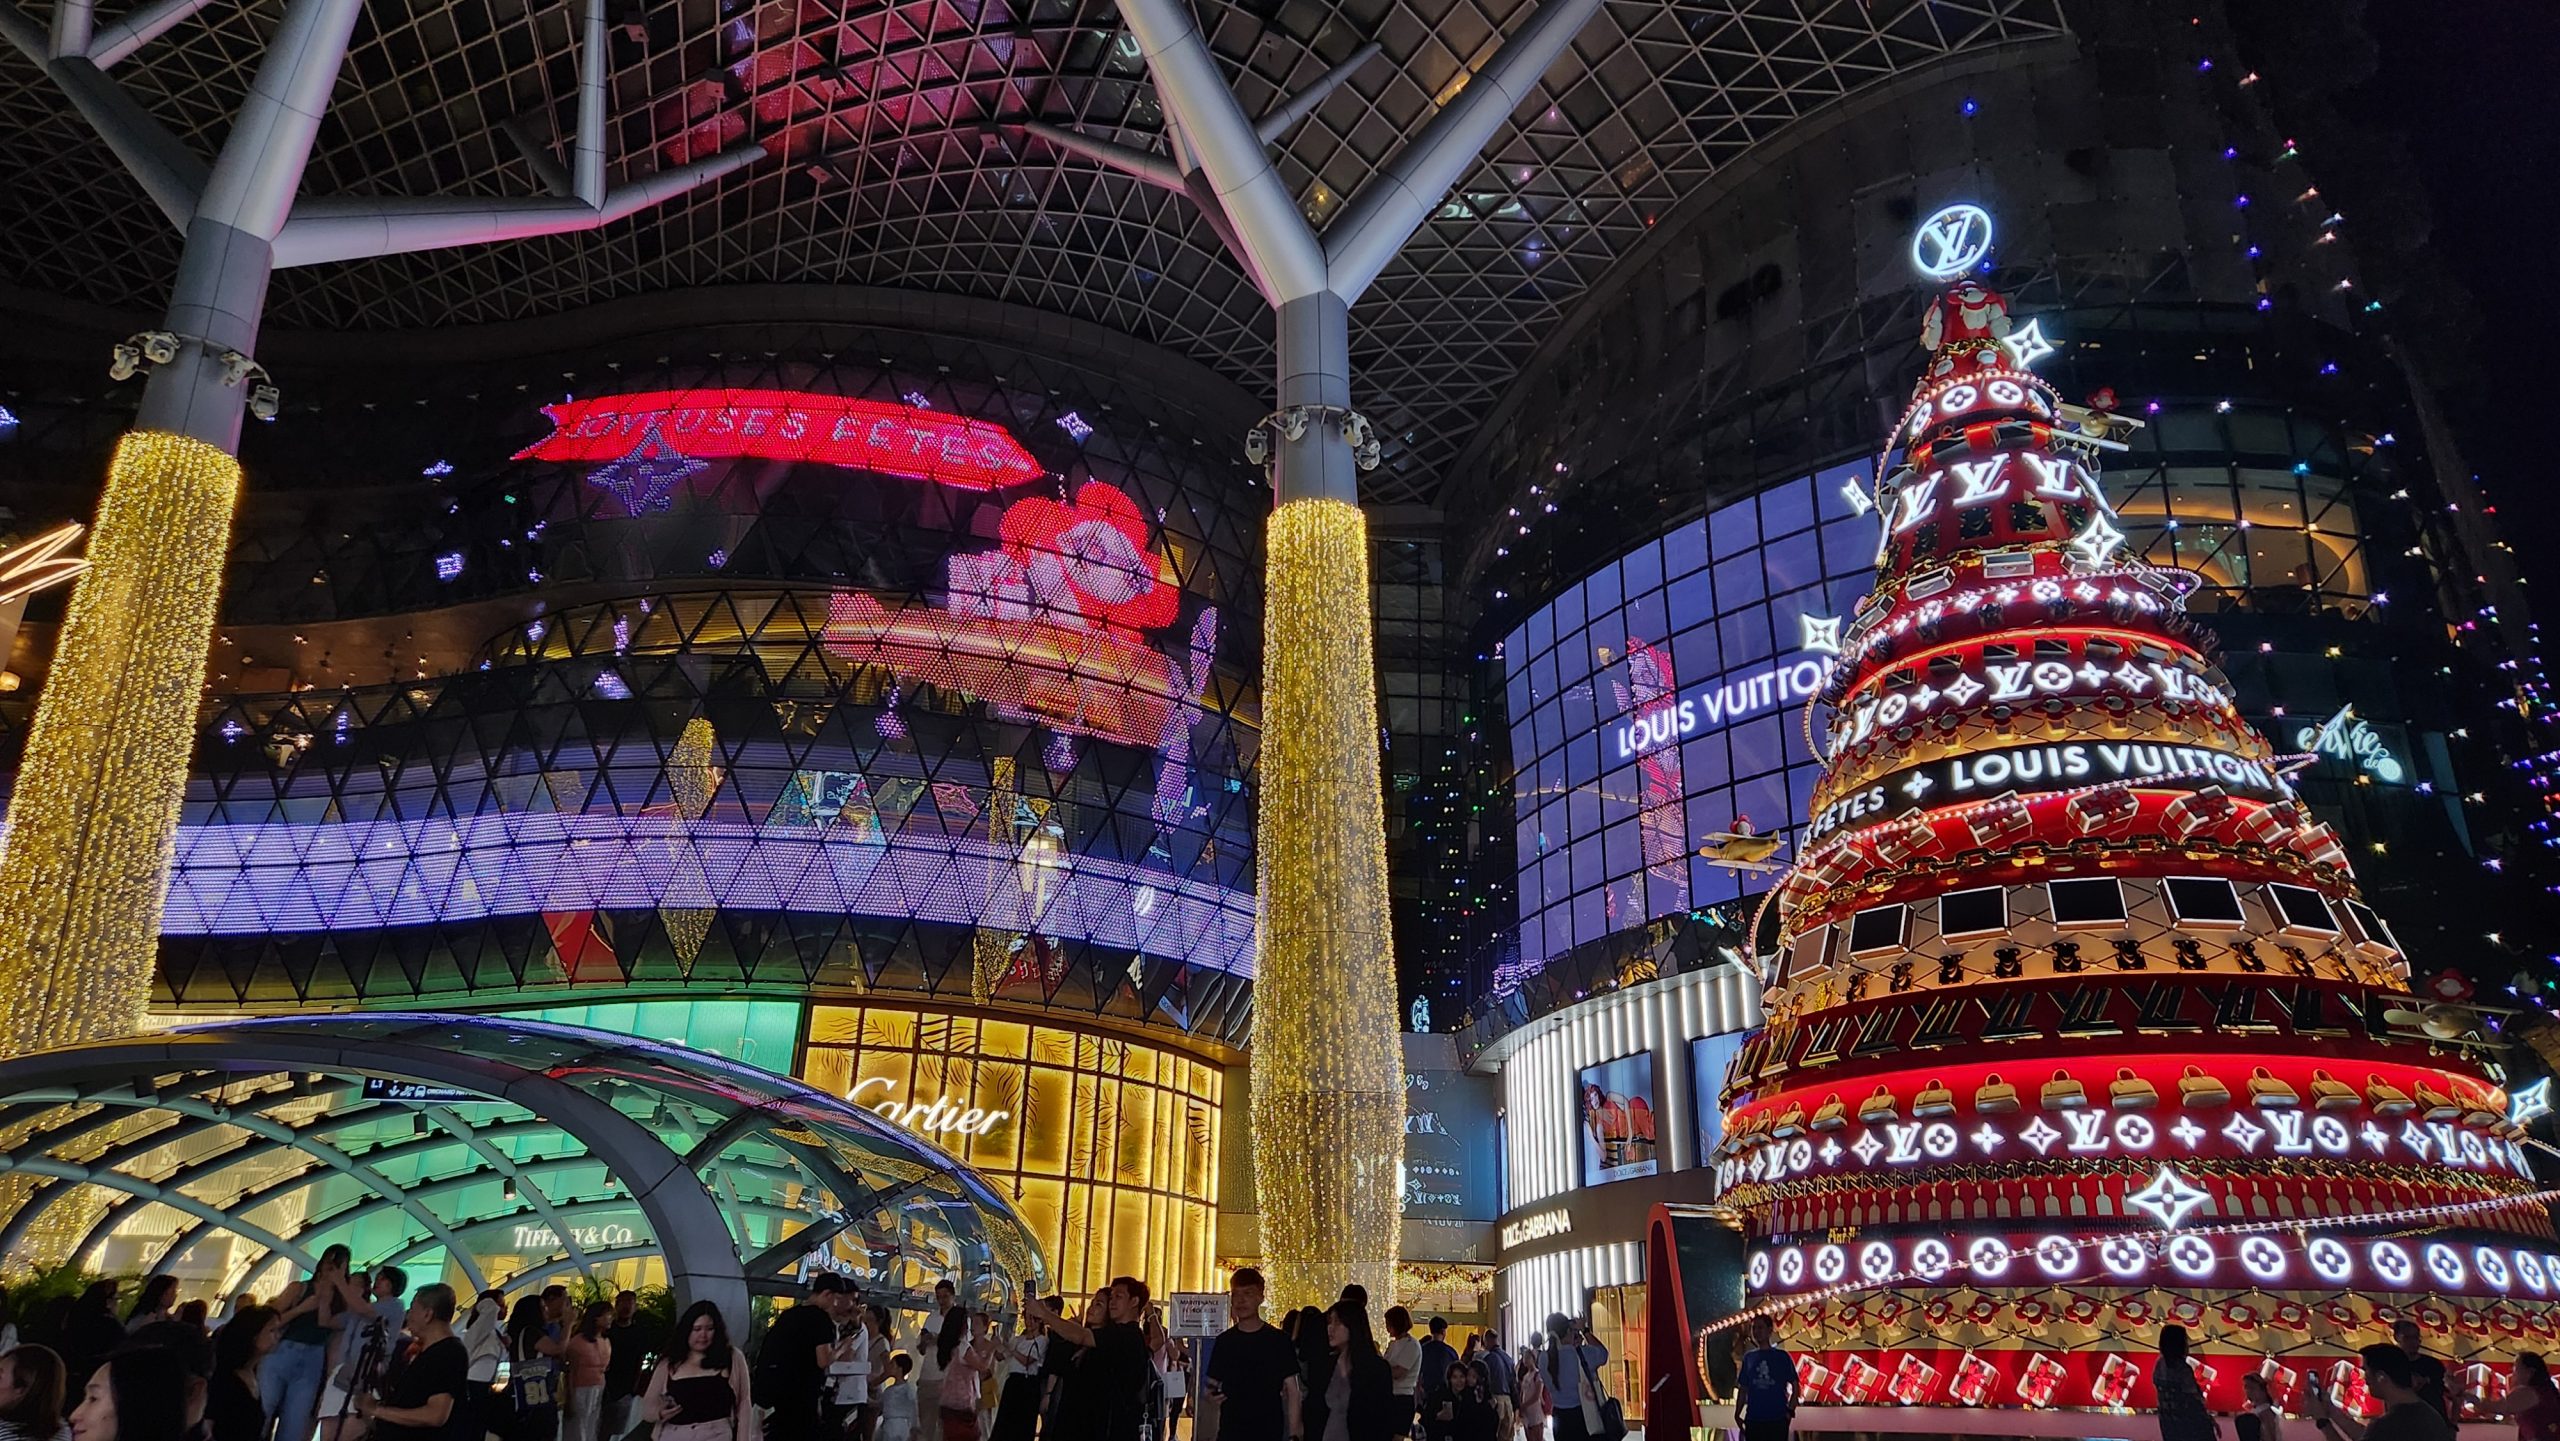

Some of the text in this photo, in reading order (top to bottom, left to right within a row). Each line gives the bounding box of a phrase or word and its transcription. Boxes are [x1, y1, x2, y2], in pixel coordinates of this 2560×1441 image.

[1618, 700, 1696, 758] LOUIS
[1952, 746, 2090, 791] LOUIS
[2097, 744, 2273, 790] VUITTON
